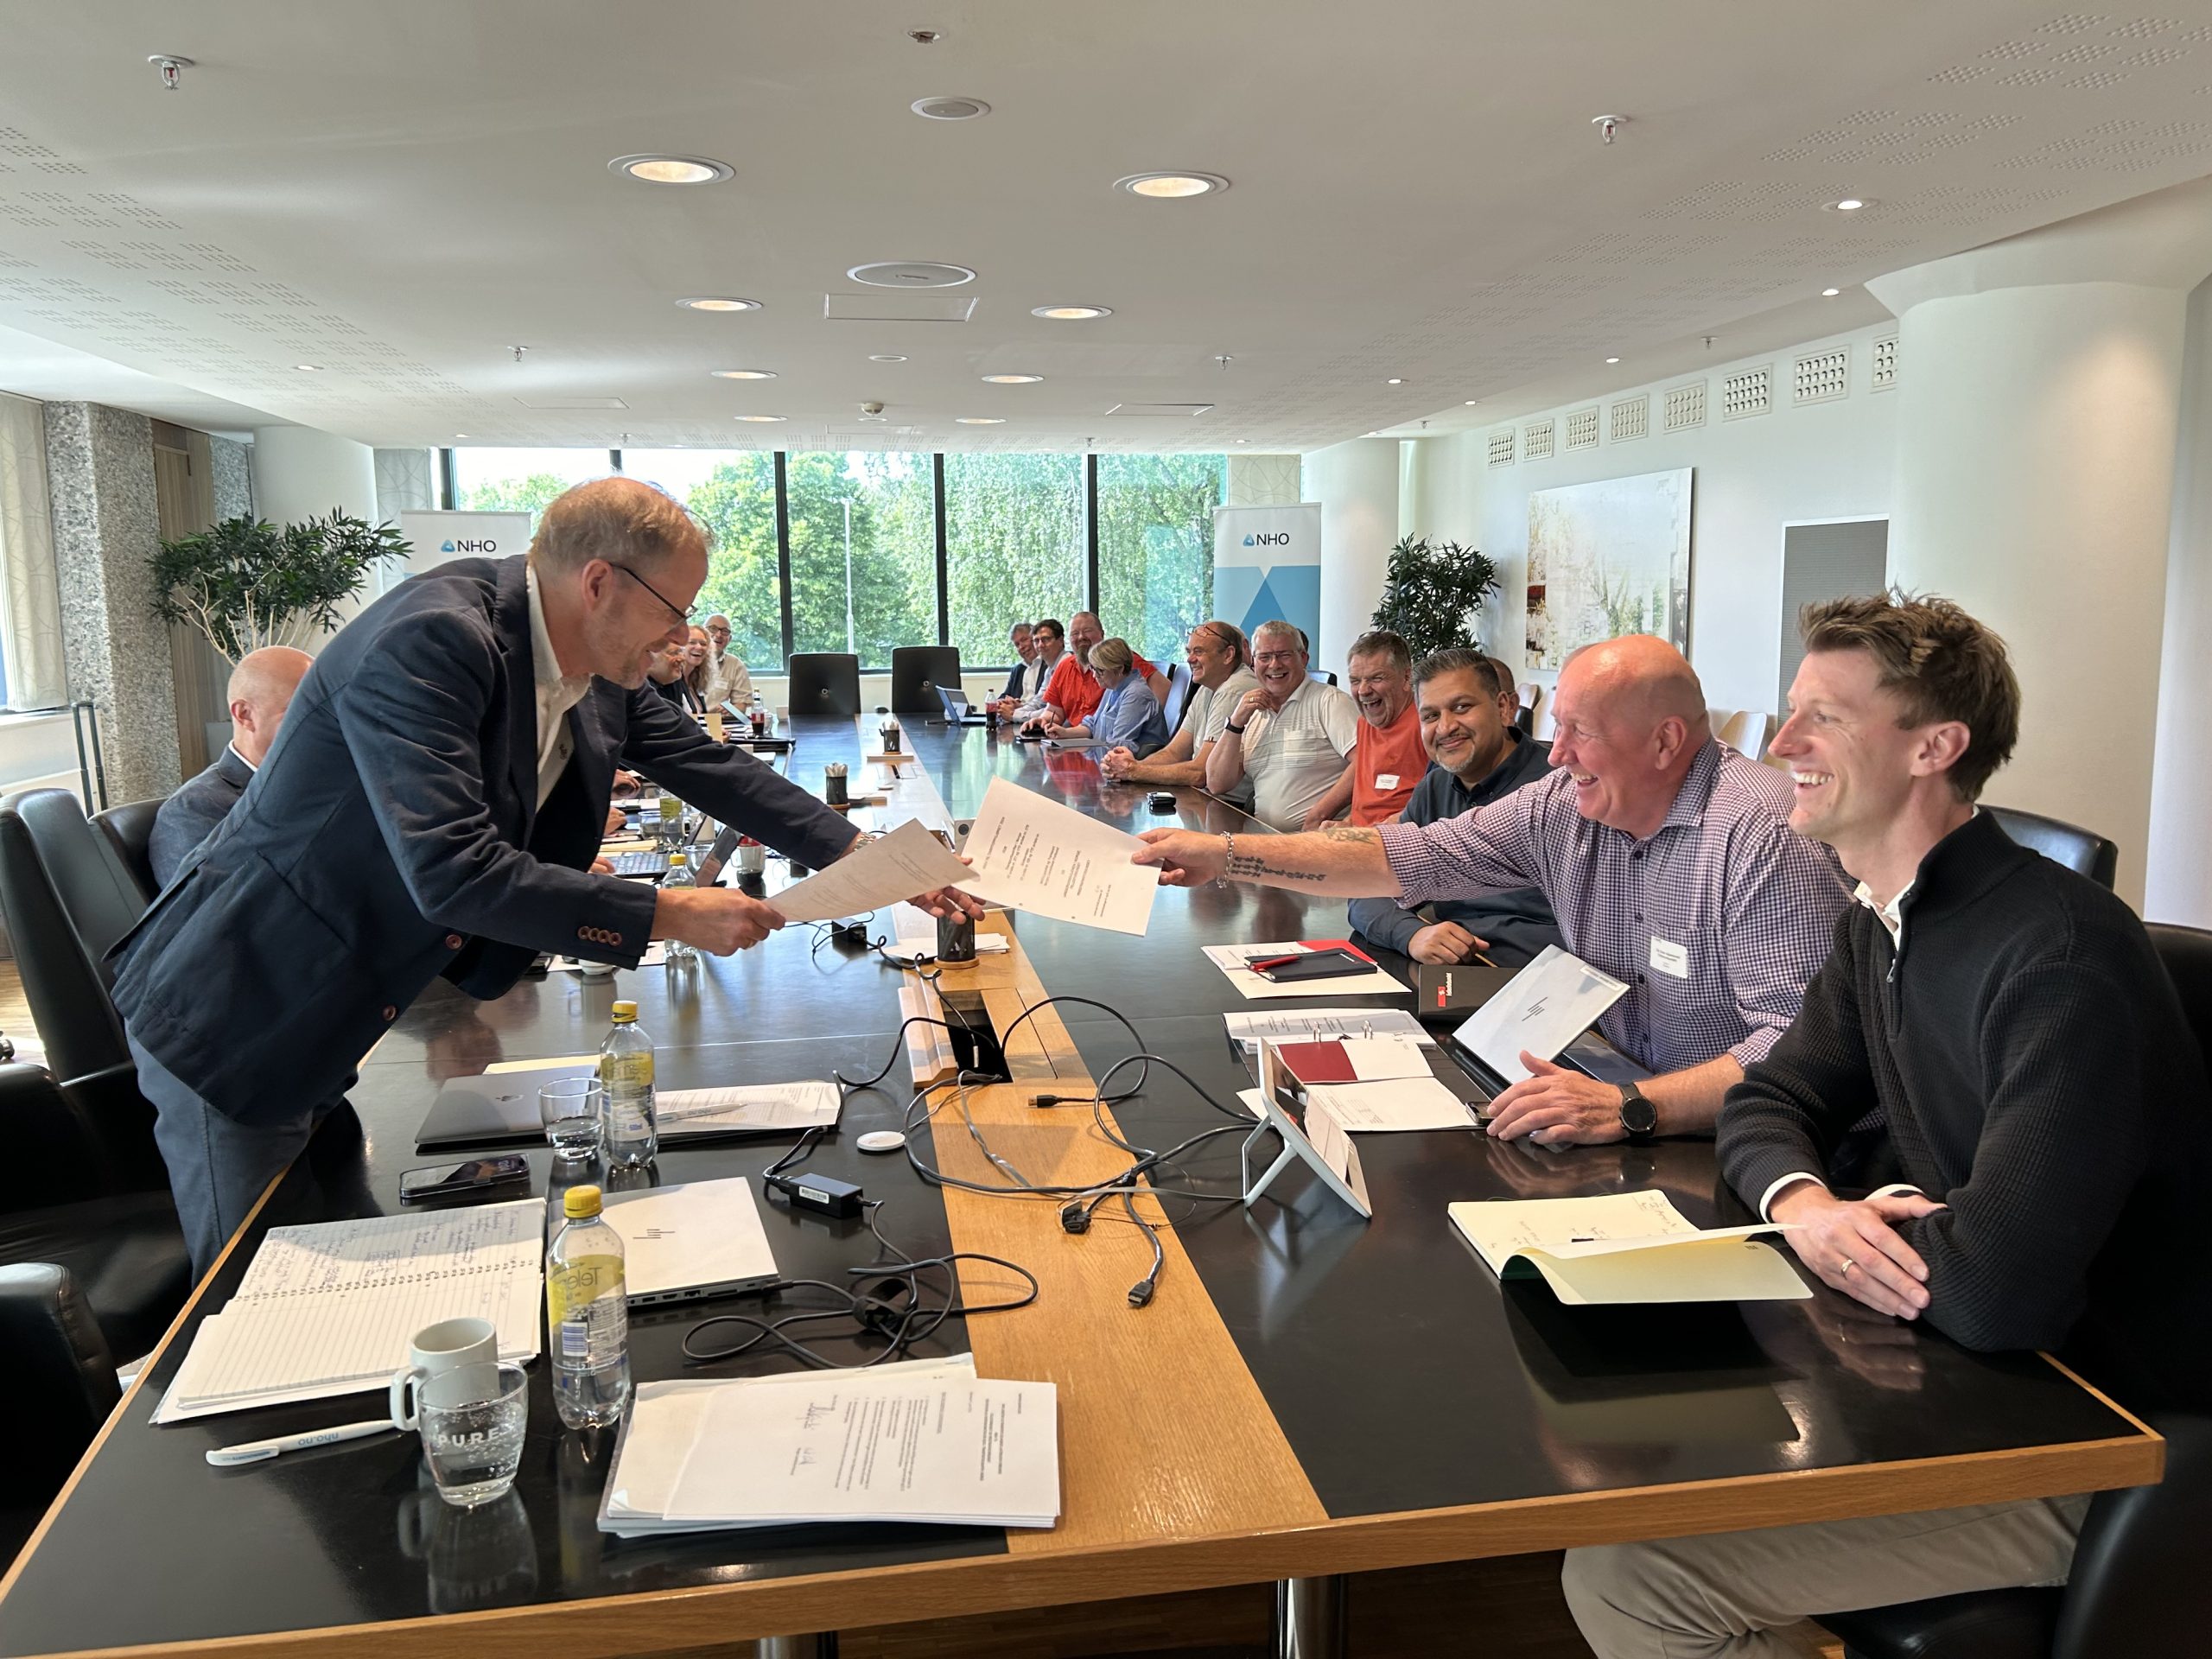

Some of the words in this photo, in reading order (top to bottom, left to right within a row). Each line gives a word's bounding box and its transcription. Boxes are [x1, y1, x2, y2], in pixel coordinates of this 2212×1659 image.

[457, 539, 497, 553] NHO
[1256, 532, 1290, 546] NHO
[297, 1432, 340, 1446] nho.no
[437, 1427, 499, 1446] PURE
